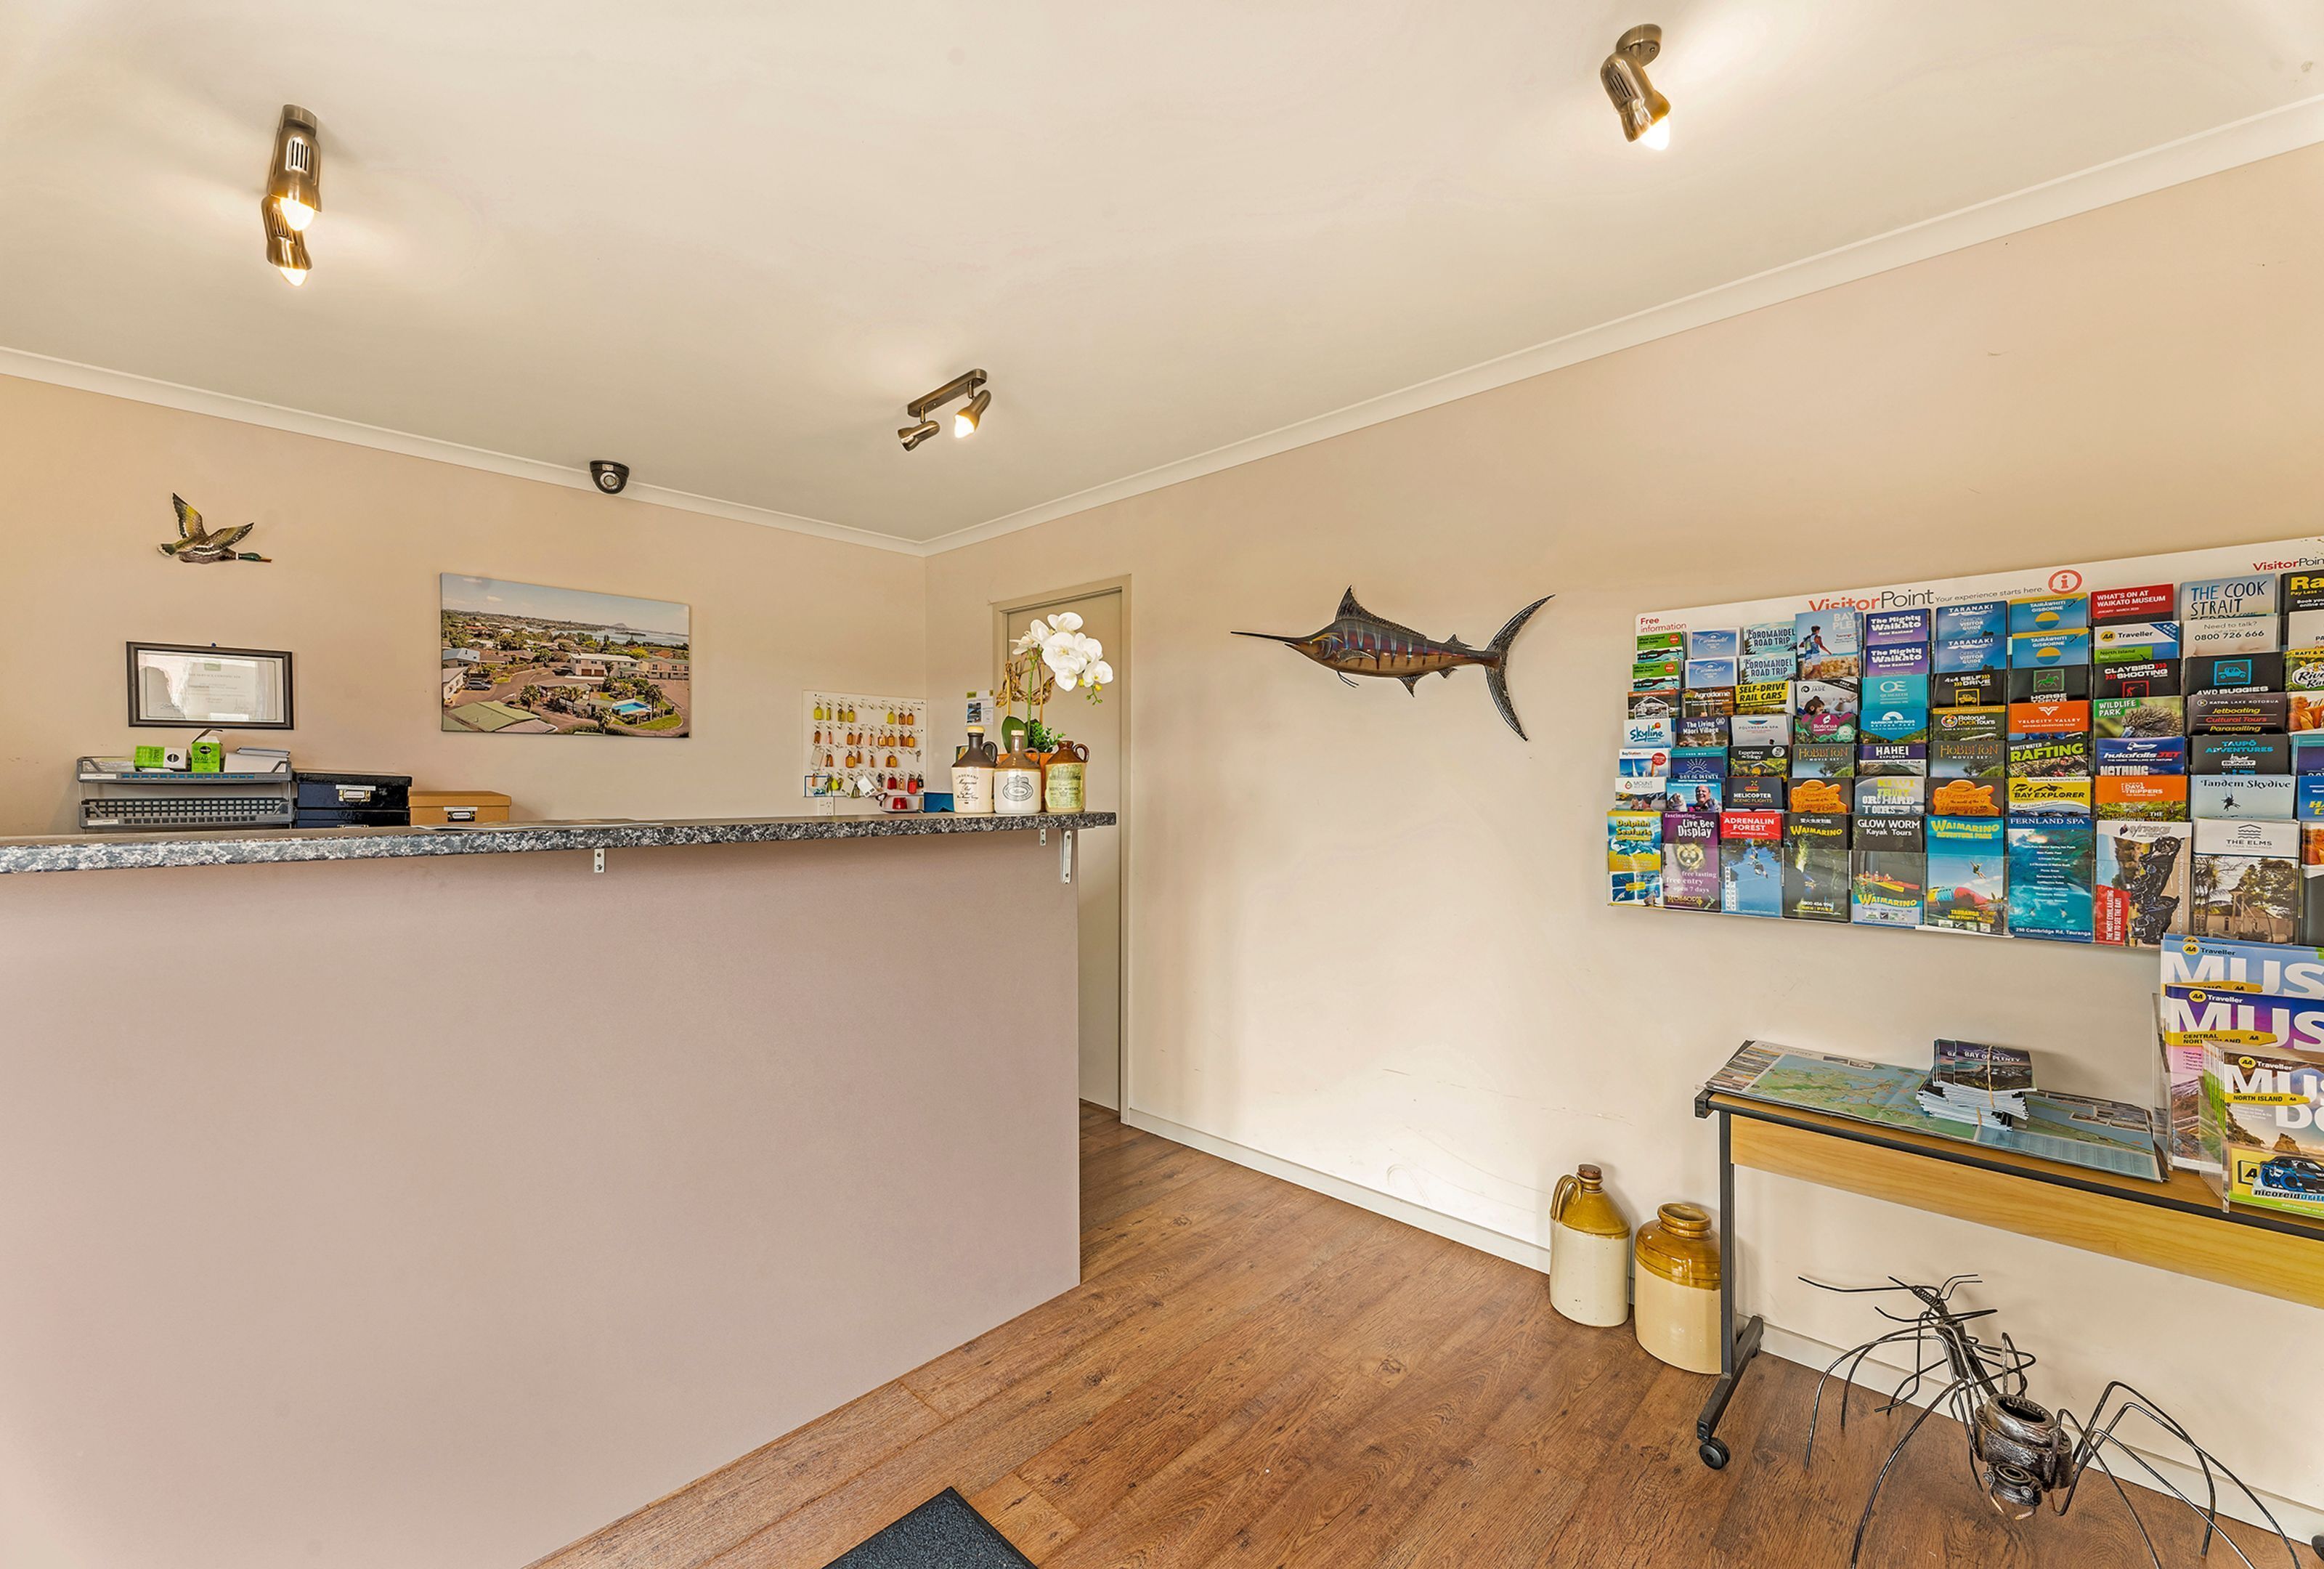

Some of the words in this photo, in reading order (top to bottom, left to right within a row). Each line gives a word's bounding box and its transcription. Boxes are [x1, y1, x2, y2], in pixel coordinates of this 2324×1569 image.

[2191, 585, 2219, 601] THE
[2225, 580, 2267, 598] COOK
[1808, 589, 1933, 612] VisitorPoint
[1955, 591, 1997, 601] experience
[2097, 599, 2130, 607] WAIKATO
[2136, 596, 2166, 604] MUSEUM
[1949, 604, 1993, 614] TARANAKI
[2190, 599, 2243, 616] STRAIT
[1889, 615, 1921, 624] Mighty
[1641, 623, 1686, 633] information
[1871, 622, 1921, 631] Waikato
[1748, 628, 1795, 639] COROMANDEL
[2118, 630, 2153, 639] Traveller
[1754, 638, 1773, 646] ROAD
[1775, 636, 1789, 645] TRIP
[1949, 638, 1993, 648] TARANAKI
[1871, 654, 1922, 663] Waikato
[1745, 659, 1792, 669] COROMANDEL
[2105, 663, 2156, 676] CLAYBIRD
[2116, 669, 2168, 679] SHOOTING
[1739, 683, 1786, 693] SELF-DRIVE
[2219, 686, 2269, 694] BUGGIES
[1762, 692, 1781, 700] CARS
[2099, 700, 2136, 710] WILDLIFE
[1700, 726, 1719, 735] Village
[1876, 746, 1909, 756] HAHEI
[2010, 742, 2042, 751] WHITEWATER
[2010, 742, 2084, 762] RAFTING
[2100, 765, 2149, 776] NOTHING
[1683, 819, 1698, 827] Live
[1857, 819, 1886, 829] GLOW
[1888, 820, 1920, 829] WORM
[1931, 821, 1999, 832] WAIMARINO
[1678, 825, 1711, 838] Display
[1789, 825, 1842, 836] WAIMARINO
[1858, 894, 1917, 907] WAIMARINO
[2206, 994, 2243, 1003] Traveller
[2256, 1061, 2293, 1071] Traveller
